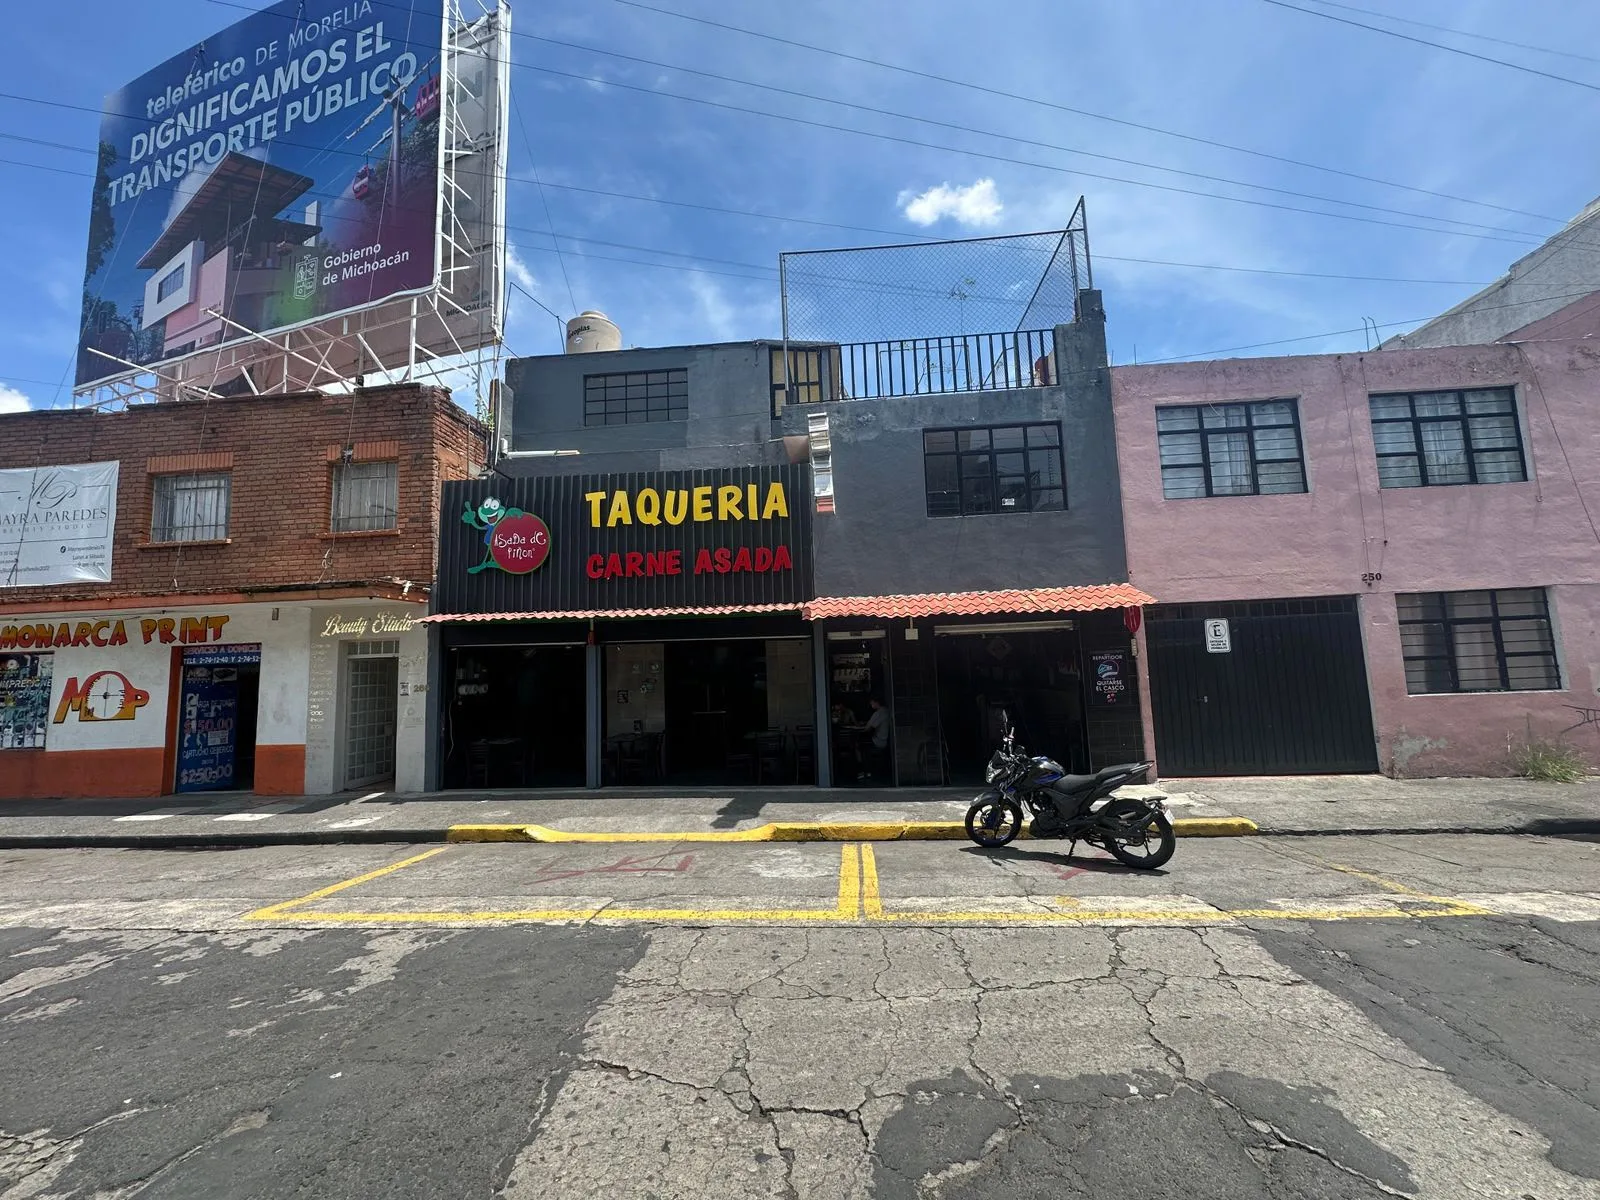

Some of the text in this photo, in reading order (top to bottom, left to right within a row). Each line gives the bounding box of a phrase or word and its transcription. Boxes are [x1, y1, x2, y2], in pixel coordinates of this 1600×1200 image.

[146, 0, 373, 118] teleférico DE MORELIA
[129, 21, 391, 164] DIGNIFICAMOS EL
[108, 52, 417, 207] TRANSPORTE PÚBLICO
[322, 250, 410, 286] de Michoacán
[323, 243, 381, 269] Gobierno
[0, 508, 107, 525] AYRA PAREDES
[585, 482, 789, 528] TAQUERIA
[586, 545, 792, 580] CARNE ASADA
[1361, 572, 1382, 581] 250
[0, 615, 229, 649] MONARCA PRINT
[320, 613, 368, 638] Beauty
